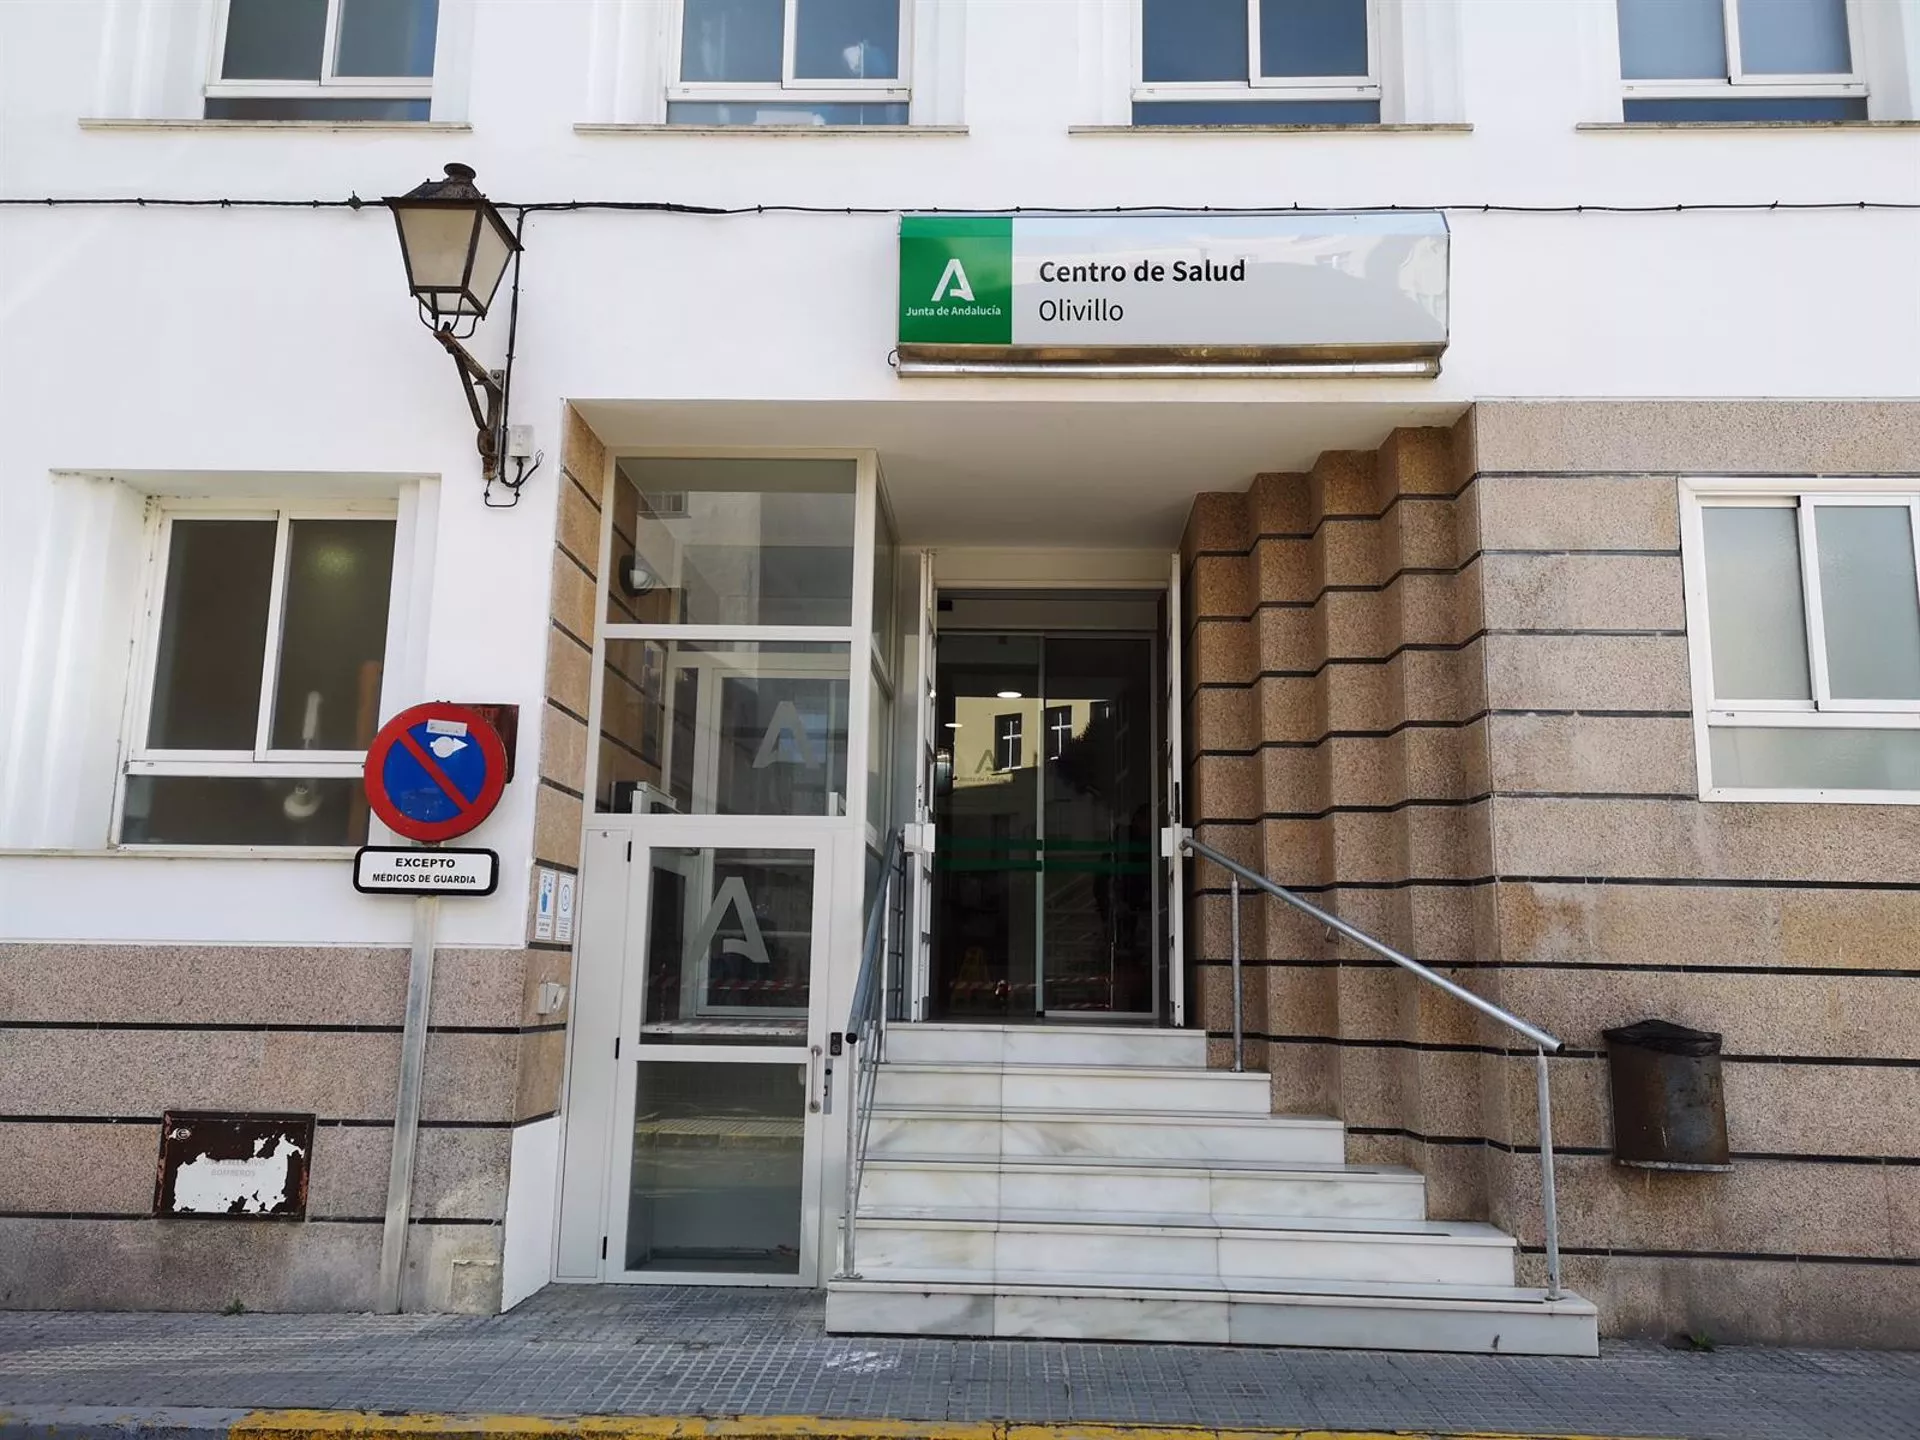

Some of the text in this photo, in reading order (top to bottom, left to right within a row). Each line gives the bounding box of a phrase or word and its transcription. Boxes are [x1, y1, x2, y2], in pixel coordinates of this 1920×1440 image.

[1039, 258, 1245, 283] Centro de Salud
[905, 305, 1001, 316] Junta de Andalucía
[1039, 297, 1124, 322] Olivillo
[395, 857, 456, 869] EXCEPTO
[418, 874, 431, 883] DE
[433, 874, 476, 884] GUARDIA
